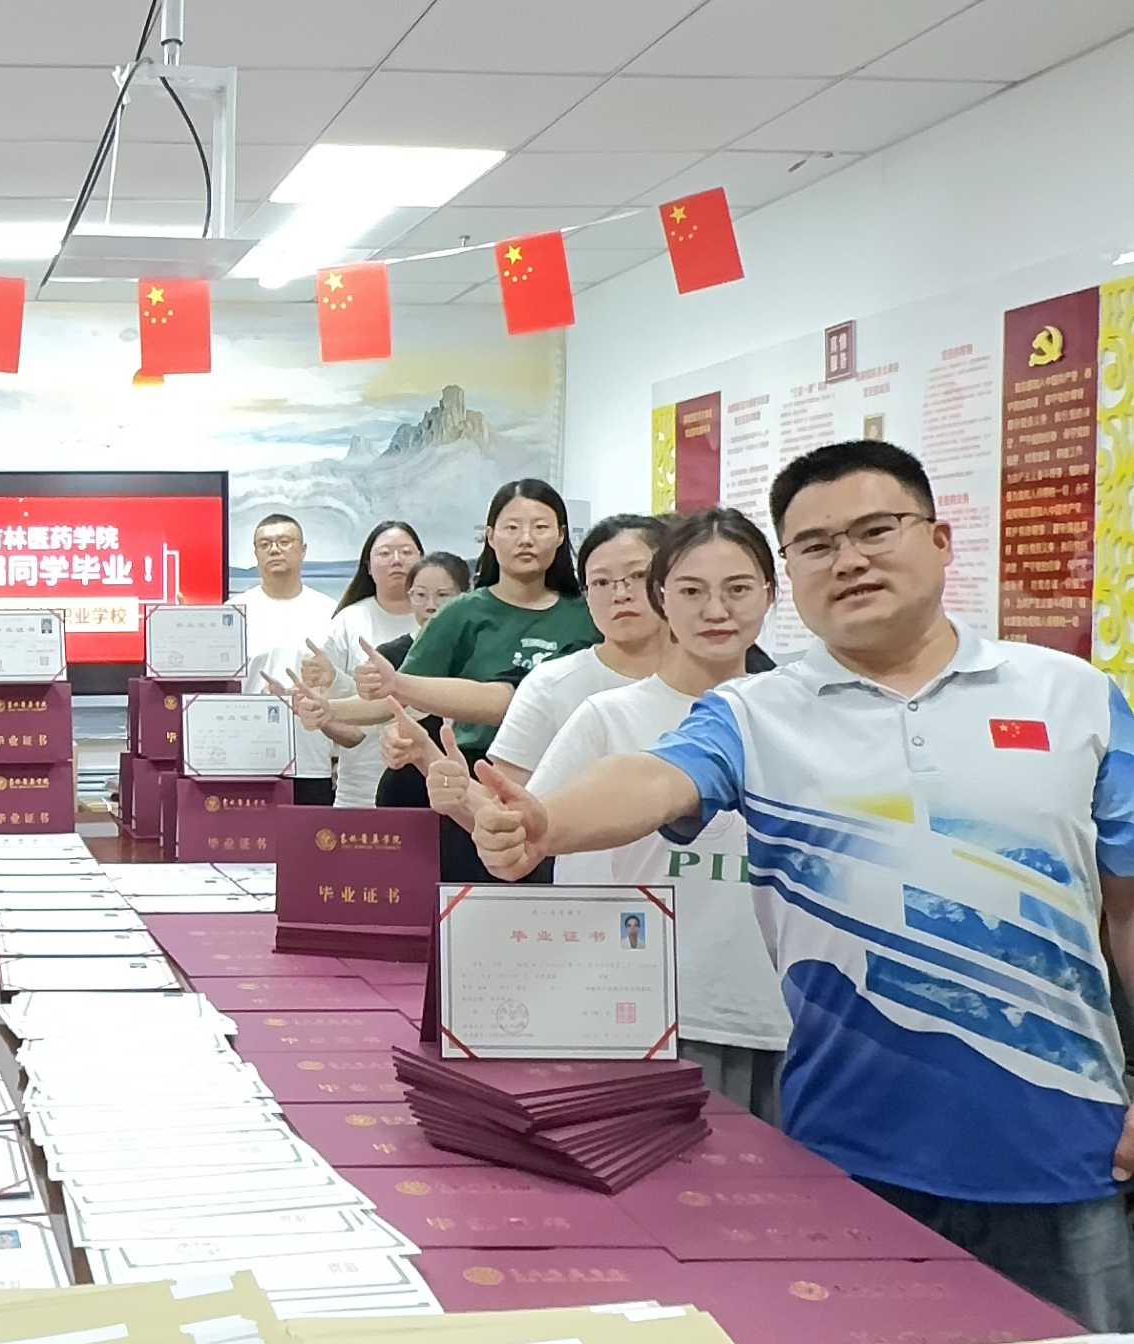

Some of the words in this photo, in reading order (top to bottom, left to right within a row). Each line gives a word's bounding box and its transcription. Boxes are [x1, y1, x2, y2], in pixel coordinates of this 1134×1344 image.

[318, 885, 401, 904] 毕业证书
[510, 929, 607, 943] 毕业证书
